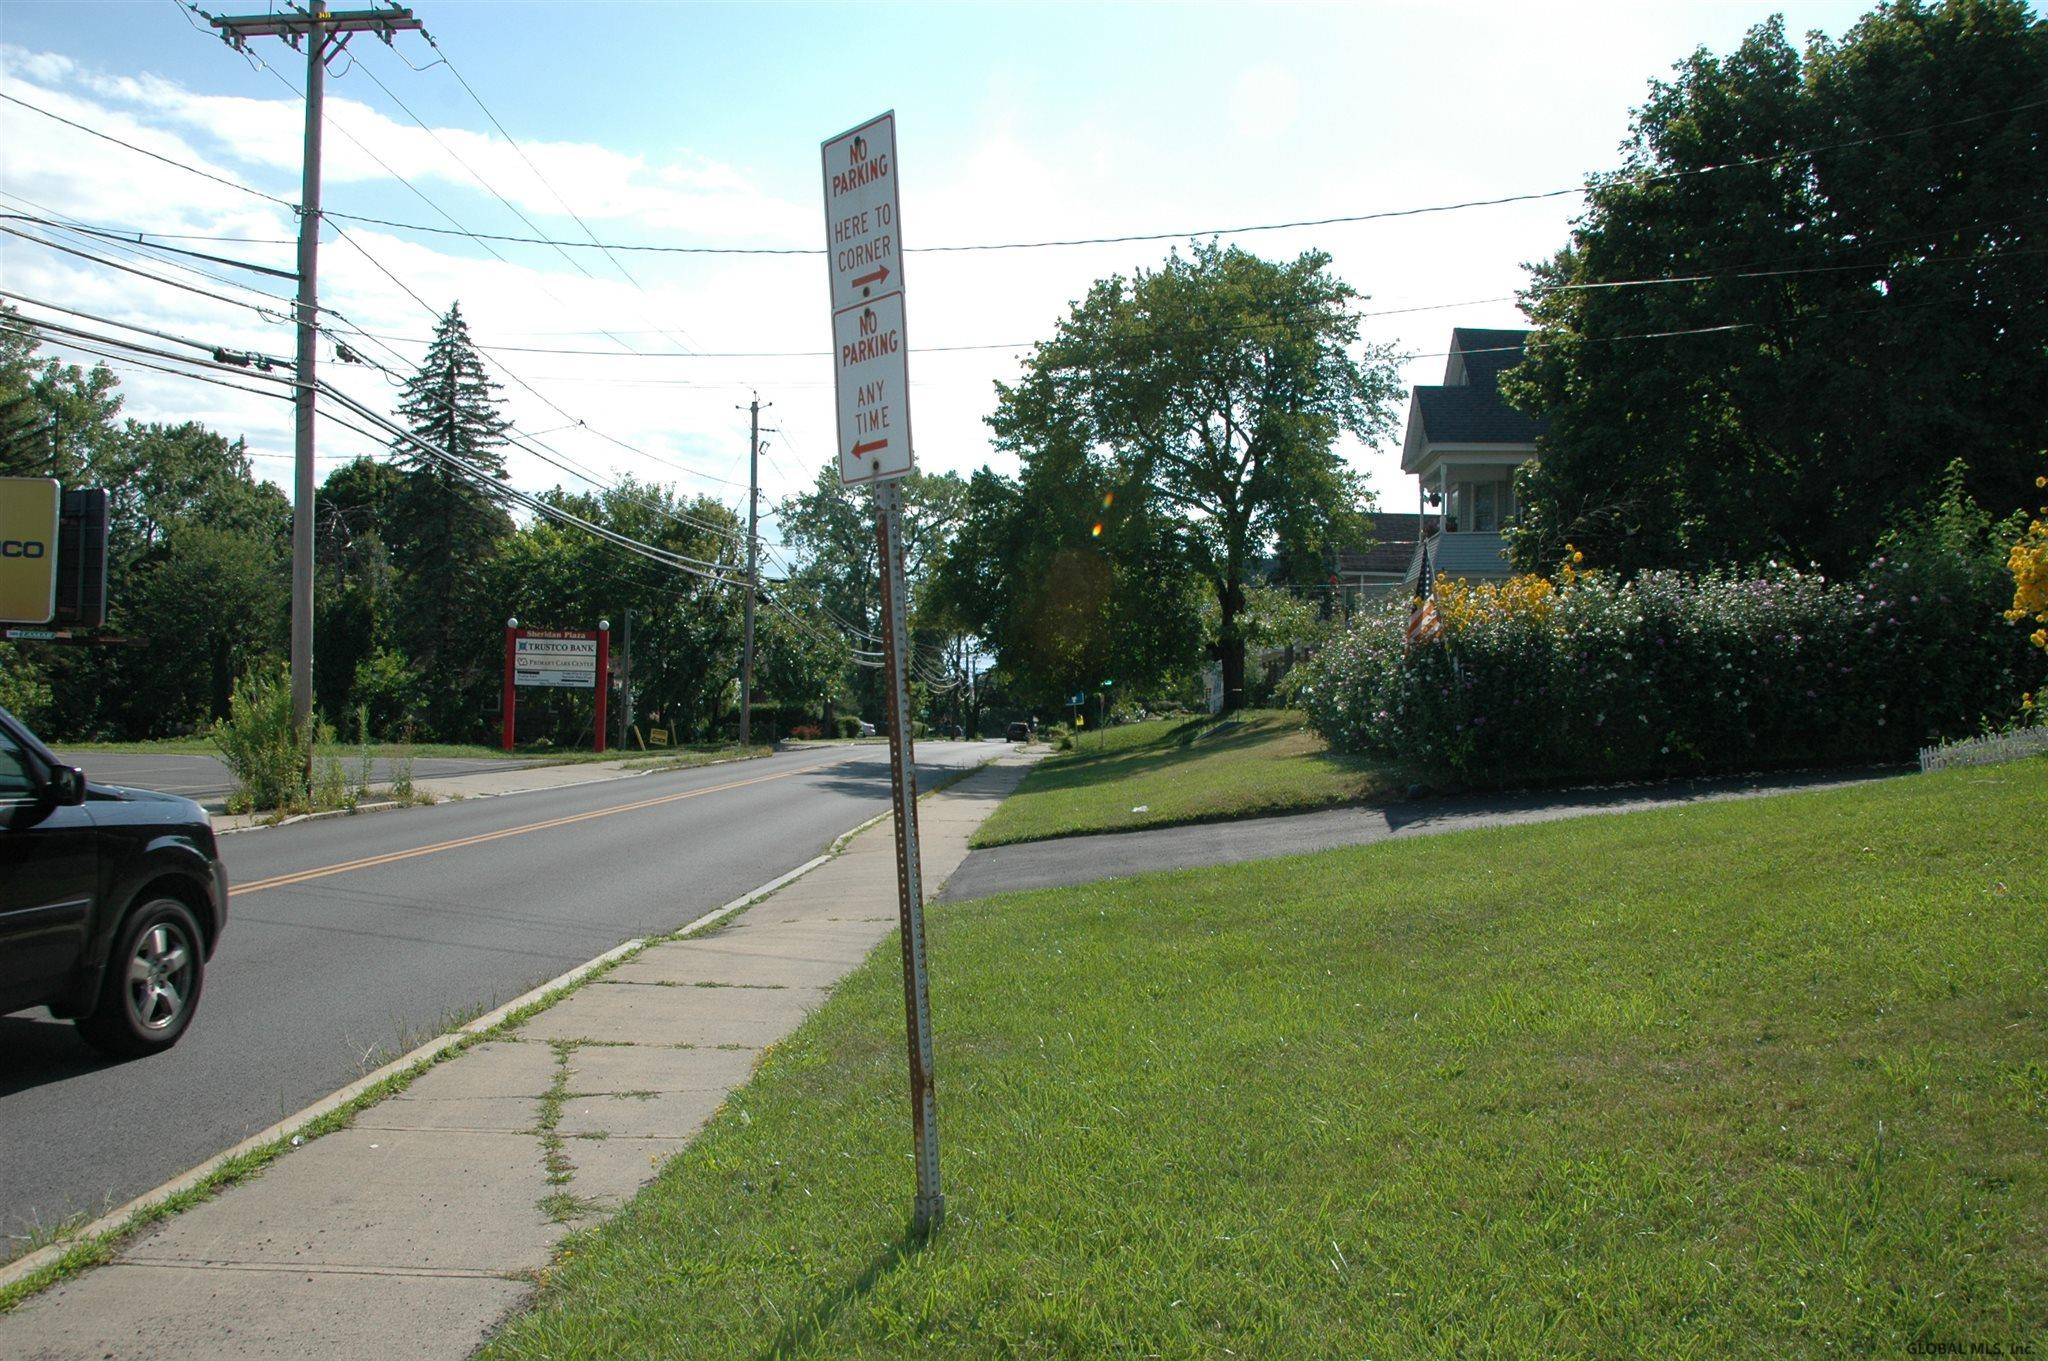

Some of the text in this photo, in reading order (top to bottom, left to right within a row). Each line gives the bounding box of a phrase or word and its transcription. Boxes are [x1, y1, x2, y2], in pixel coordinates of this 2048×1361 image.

[849, 138, 868, 165] NO
[832, 154, 888, 197] PARKING
[835, 203, 891, 244] HERE TO
[838, 235, 891, 272] CORNER
[859, 311, 877, 337] NO
[843, 329, 898, 367] PARKING
[857, 379, 884, 408] ANY
[856, 406, 890, 435] TIME
[0, 541, 44, 558] CO
[528, 642, 594, 652] TRUSTCO BANK
[564, 631, 586, 639] Plaza
